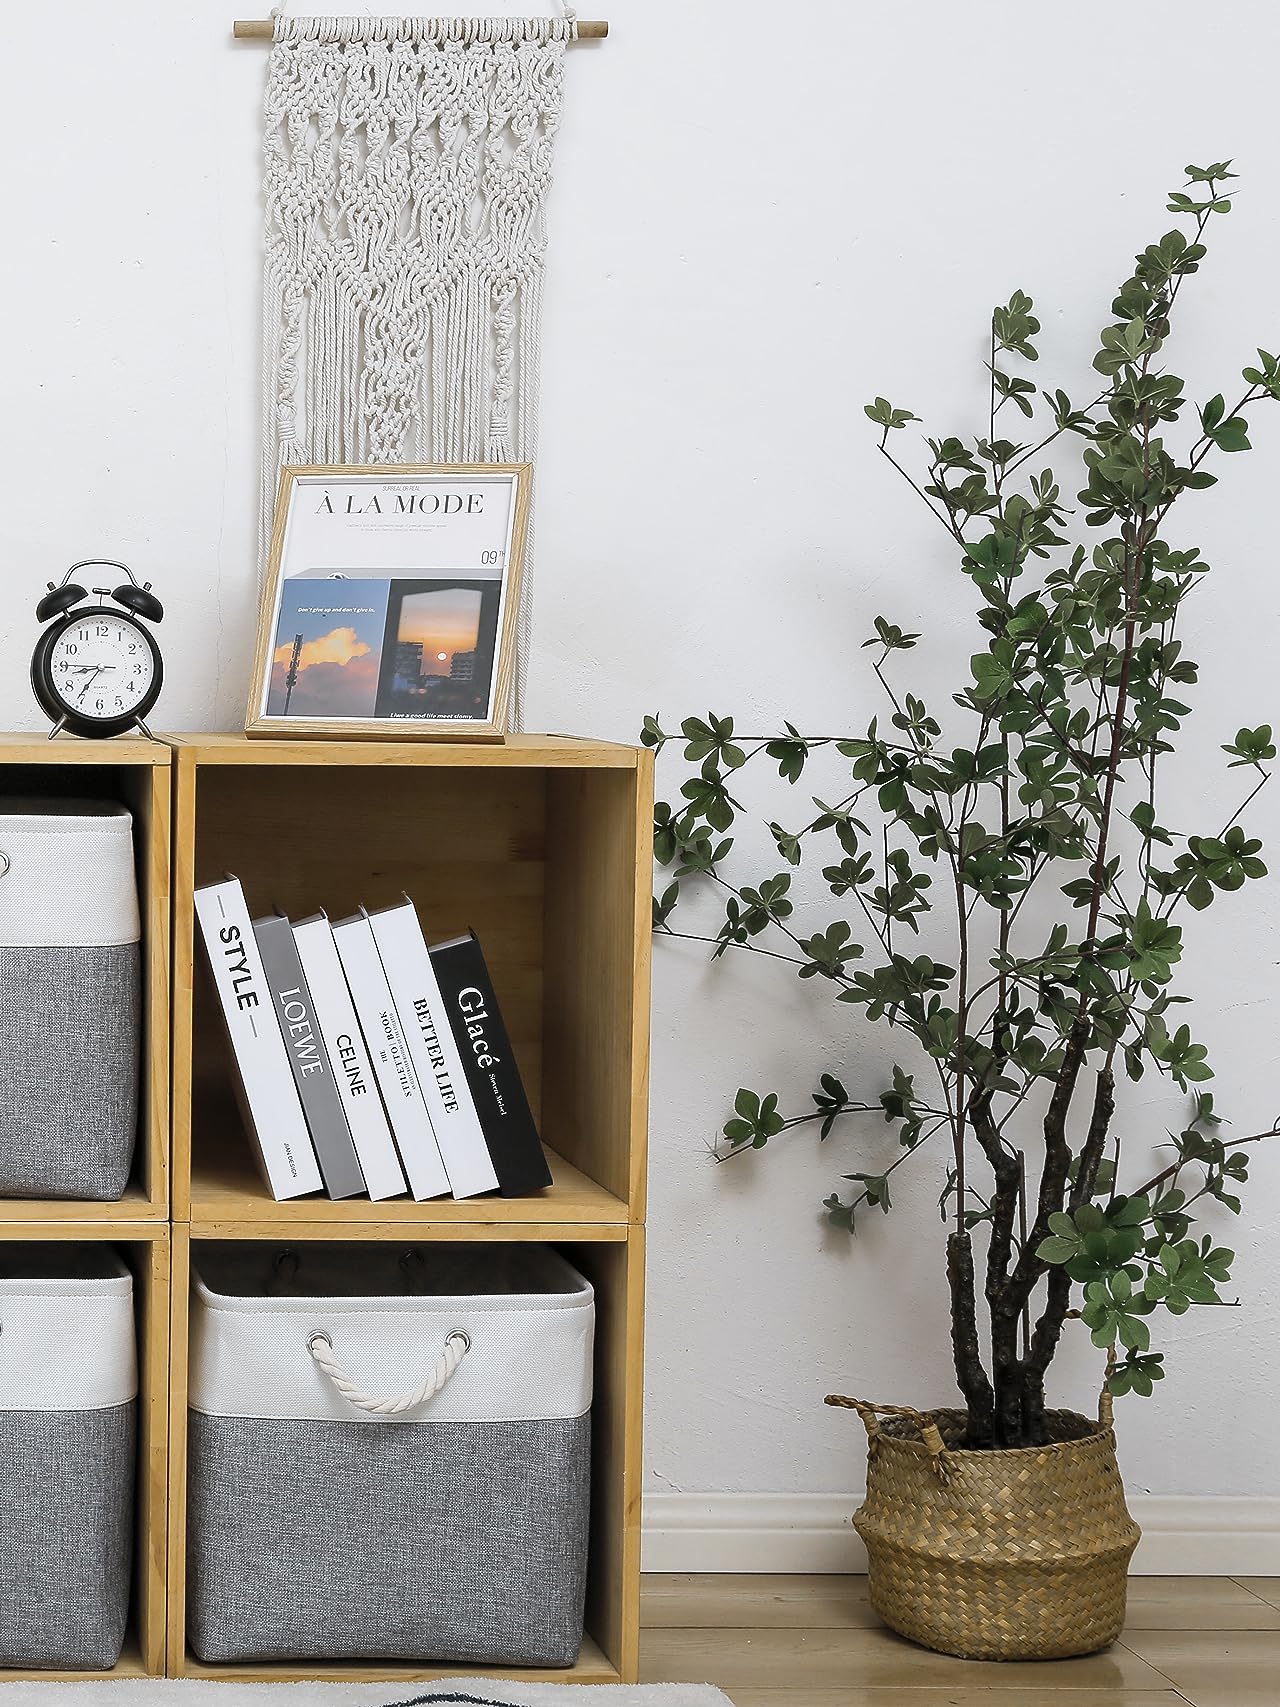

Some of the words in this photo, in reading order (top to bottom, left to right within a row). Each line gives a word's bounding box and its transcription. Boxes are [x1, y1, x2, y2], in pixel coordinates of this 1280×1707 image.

[314, 489, 334, 514] À
[343, 494, 384, 514] LA
[392, 493, 484, 515] MODE
[481, 550, 498, 565] 09
[78, 629, 90, 641] 11
[95, 625, 109, 637] 12
[117, 631, 122, 642] 1
[65, 643, 77, 655] 10
[128, 643, 137, 655] 2
[59, 660, 69, 673] 9
[132, 663, 142, 675] 3
[64, 679, 74, 692] 8
[126, 680, 135, 692] 4
[95, 698, 104, 711] 6
[114, 695, 123, 707] 5
[220, 926, 259, 1010] STYLE
[279, 987, 323, 1077] LOEWE
[379, 1011, 396, 1045] BOOK
[459, 987, 500, 1068] Glacé
[413, 998, 444, 1069] BETTER
[435, 1072, 459, 1113] LIFE
[337, 1035, 366, 1096] CELINE
[383, 1047, 412, 1097] STILETTO
